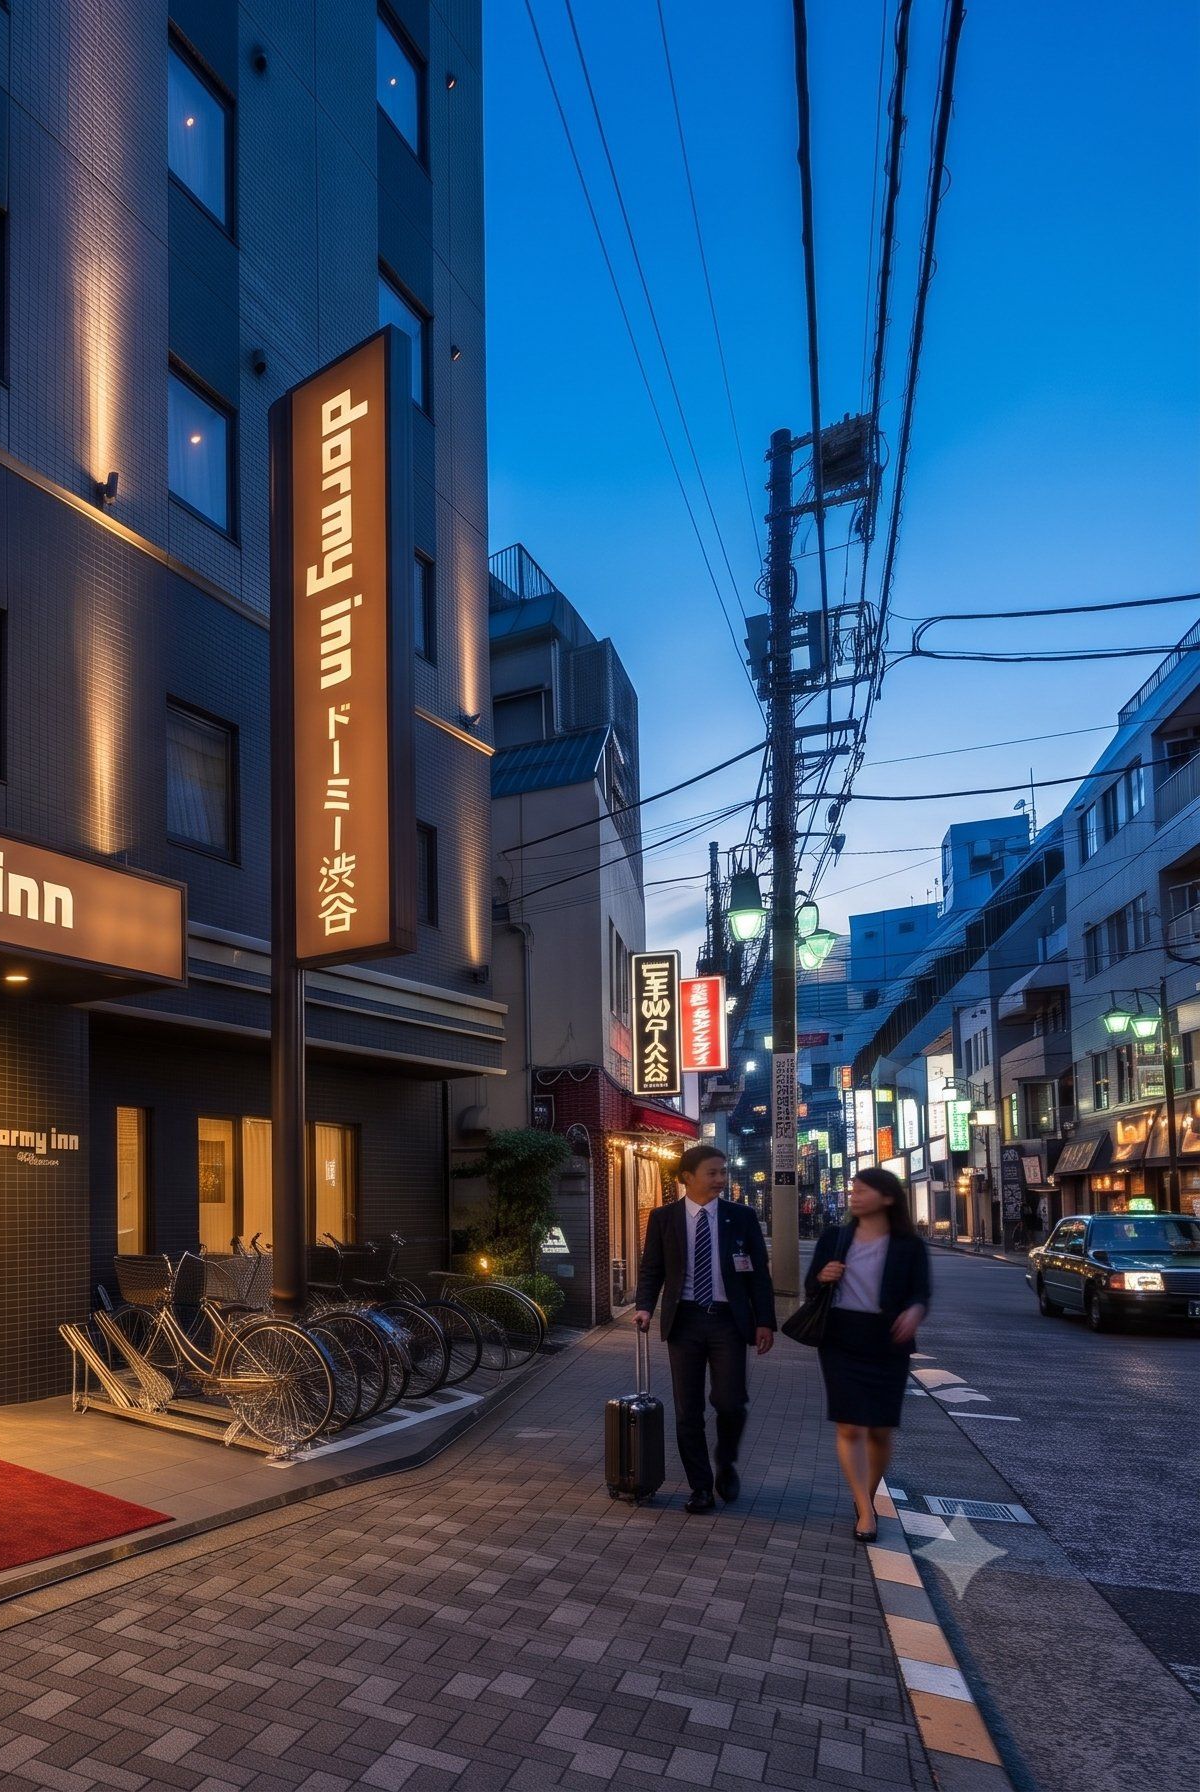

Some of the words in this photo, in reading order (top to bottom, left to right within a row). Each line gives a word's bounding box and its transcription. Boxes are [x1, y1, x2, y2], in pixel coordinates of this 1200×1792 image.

[306, 388, 368, 597] dormy
[320, 593, 363, 690] inn
[318, 702, 358, 937] ドーミー渋谷
[50, 1127, 79, 1150] inn
